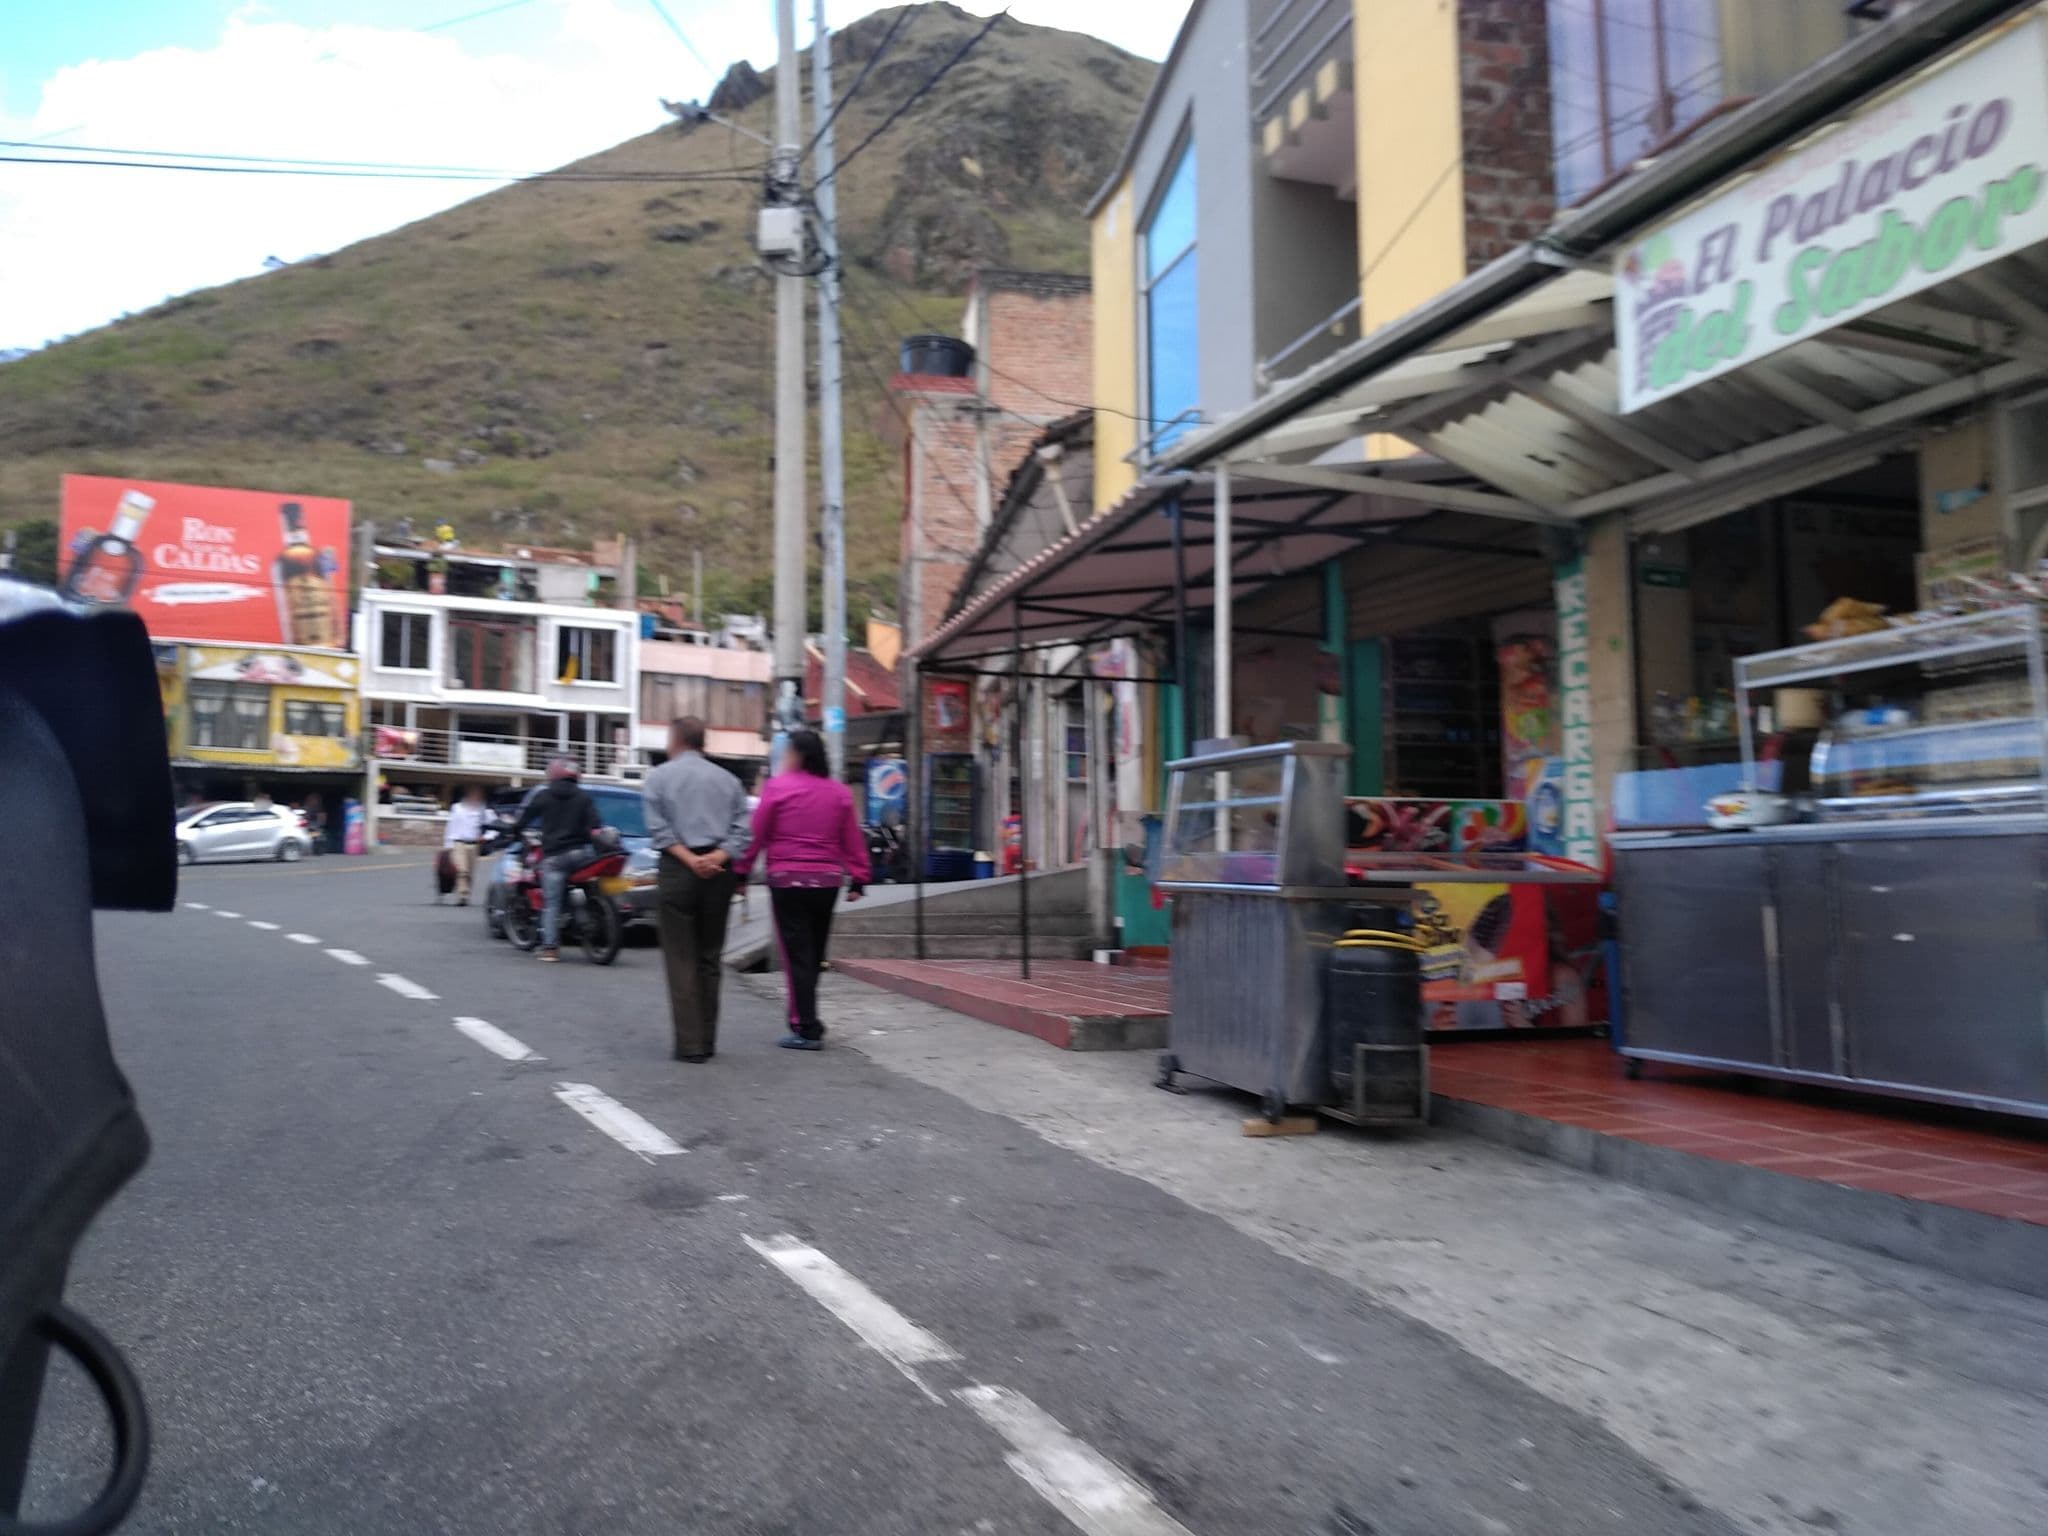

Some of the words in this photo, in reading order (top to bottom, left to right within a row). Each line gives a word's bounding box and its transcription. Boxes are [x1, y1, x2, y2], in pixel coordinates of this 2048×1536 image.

[1649, 278, 1754, 390] del
[1774, 164, 2045, 335] Sabor
[1691, 222, 1740, 296] El
[1755, 97, 2013, 264] Palacio
